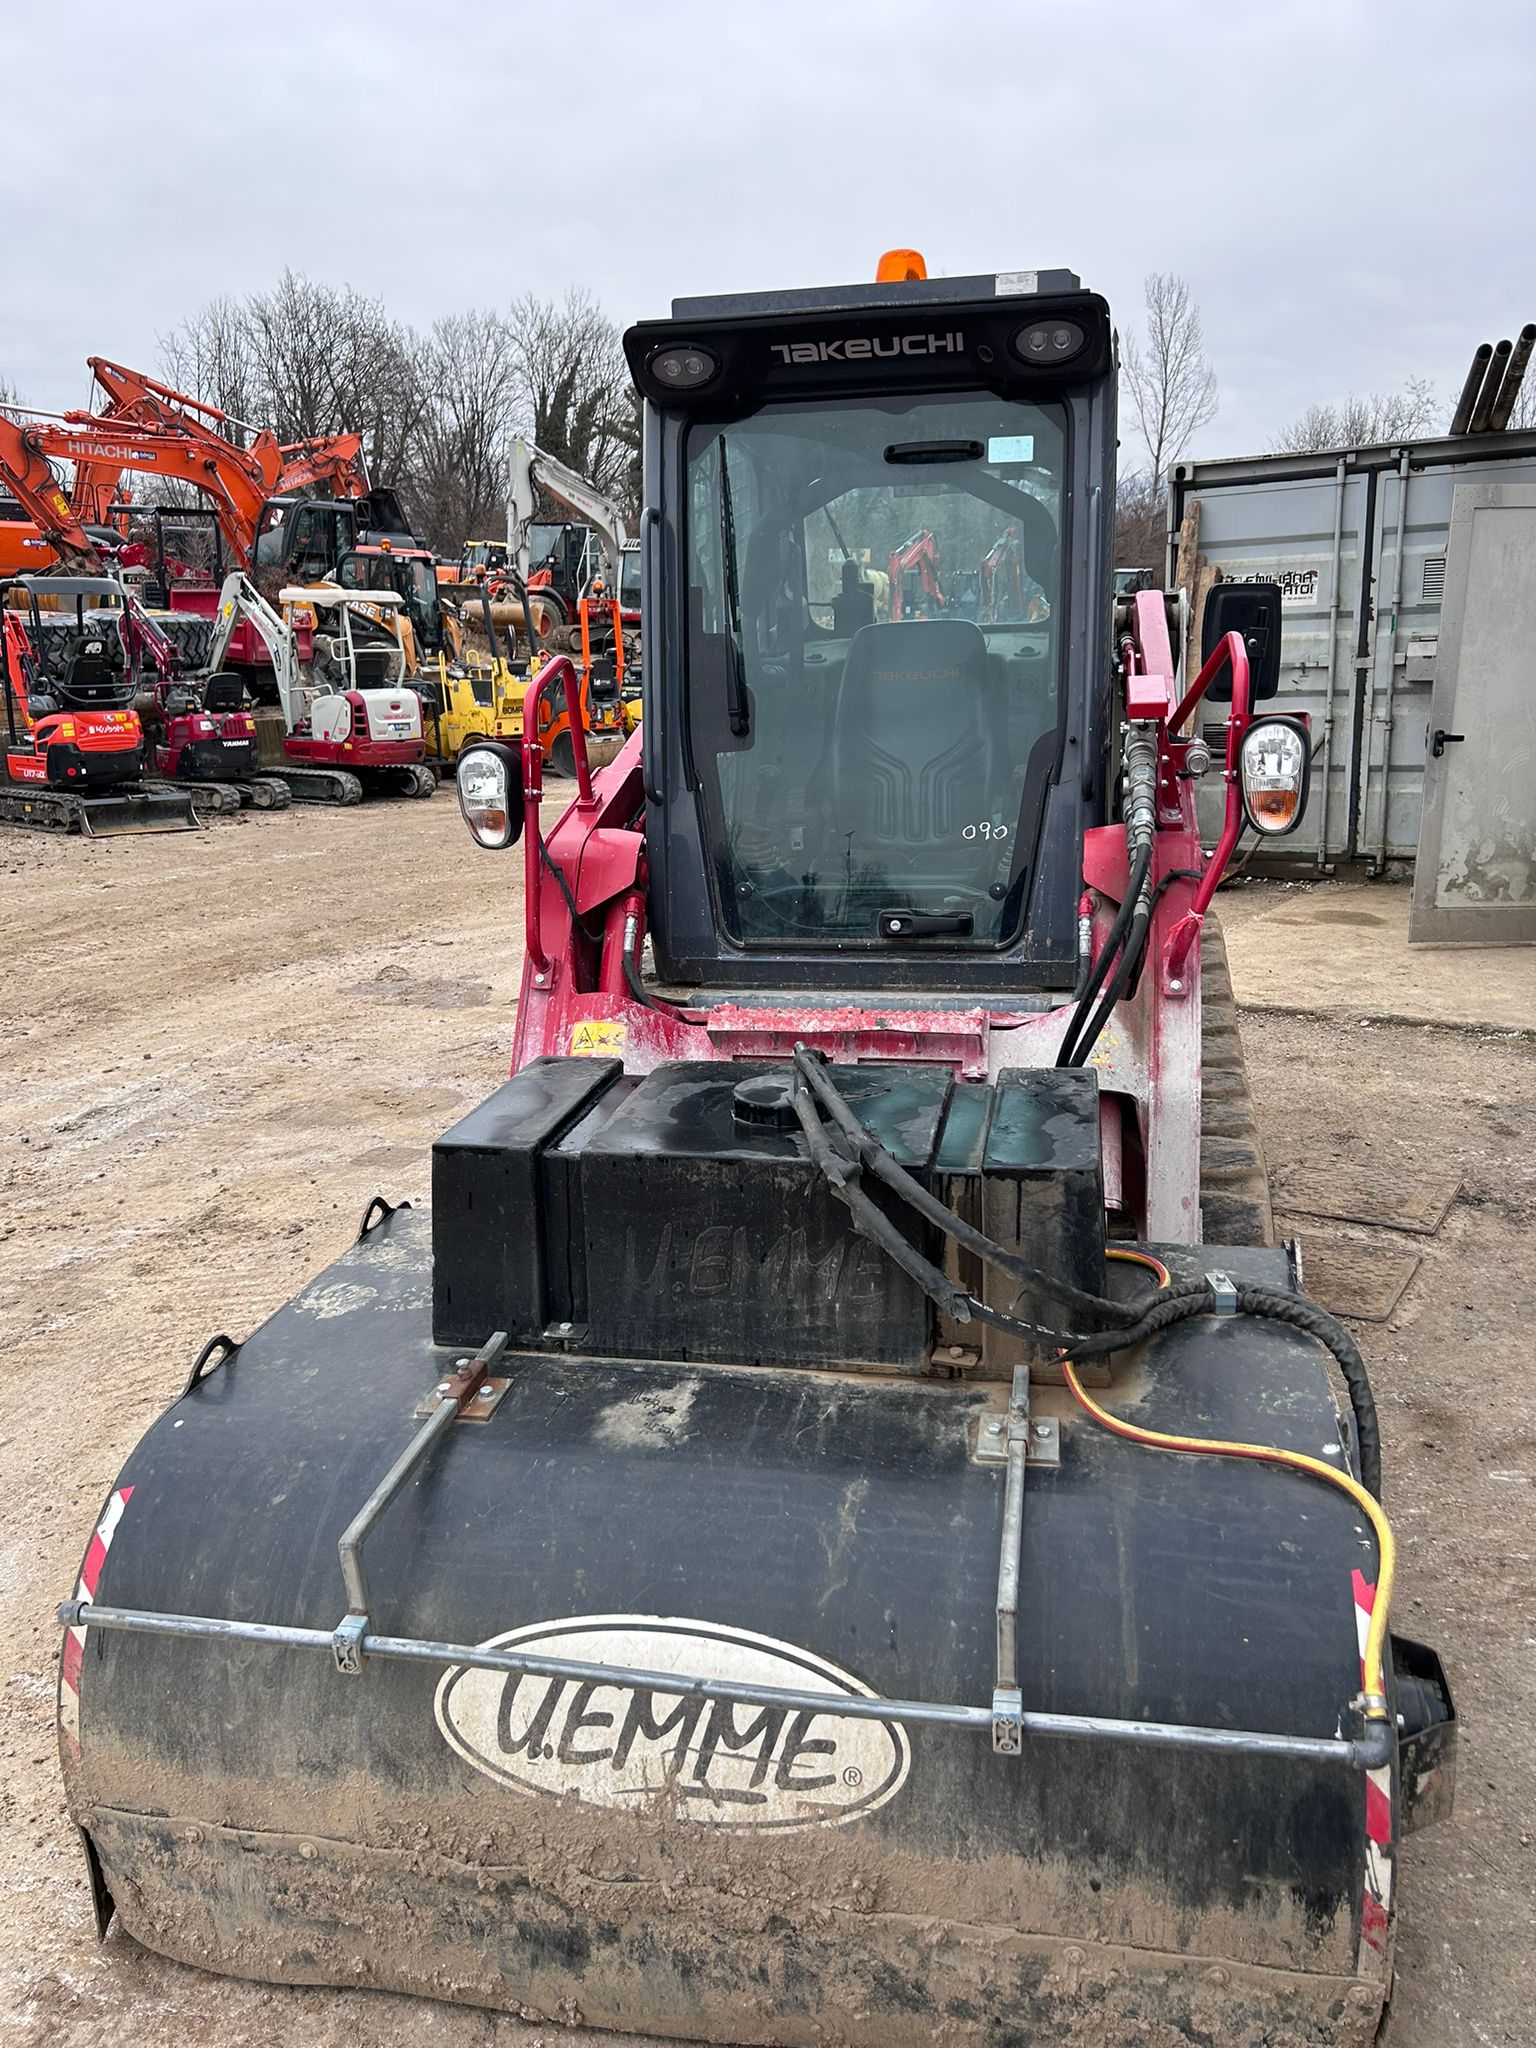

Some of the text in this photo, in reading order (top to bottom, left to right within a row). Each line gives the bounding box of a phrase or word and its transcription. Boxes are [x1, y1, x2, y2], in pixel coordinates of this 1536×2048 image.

[770, 332, 964, 363] TAKEUCHI
[68, 440, 132, 459] HITACHI
[962, 821, 1008, 840] 090
